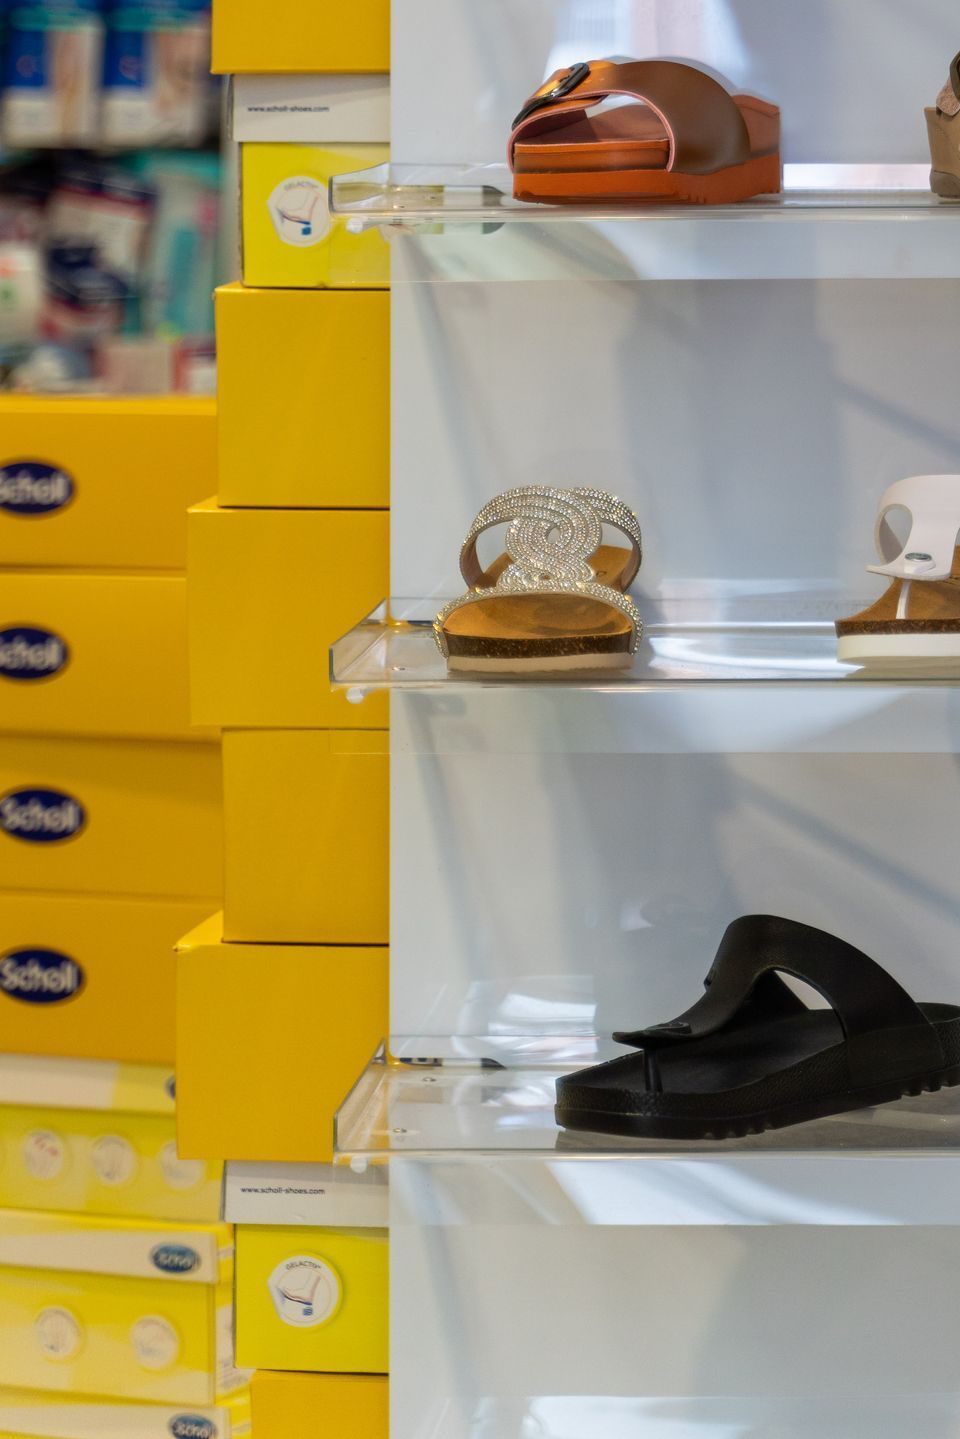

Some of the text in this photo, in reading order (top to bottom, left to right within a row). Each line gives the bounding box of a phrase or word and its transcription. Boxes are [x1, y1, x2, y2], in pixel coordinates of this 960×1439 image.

[0, 636, 63, 670] choll
[1, 797, 80, 832] Scholl
[0, 958, 79, 993] Scholl
[240, 1186, 326, 1195] www.scholl-shoes.com
